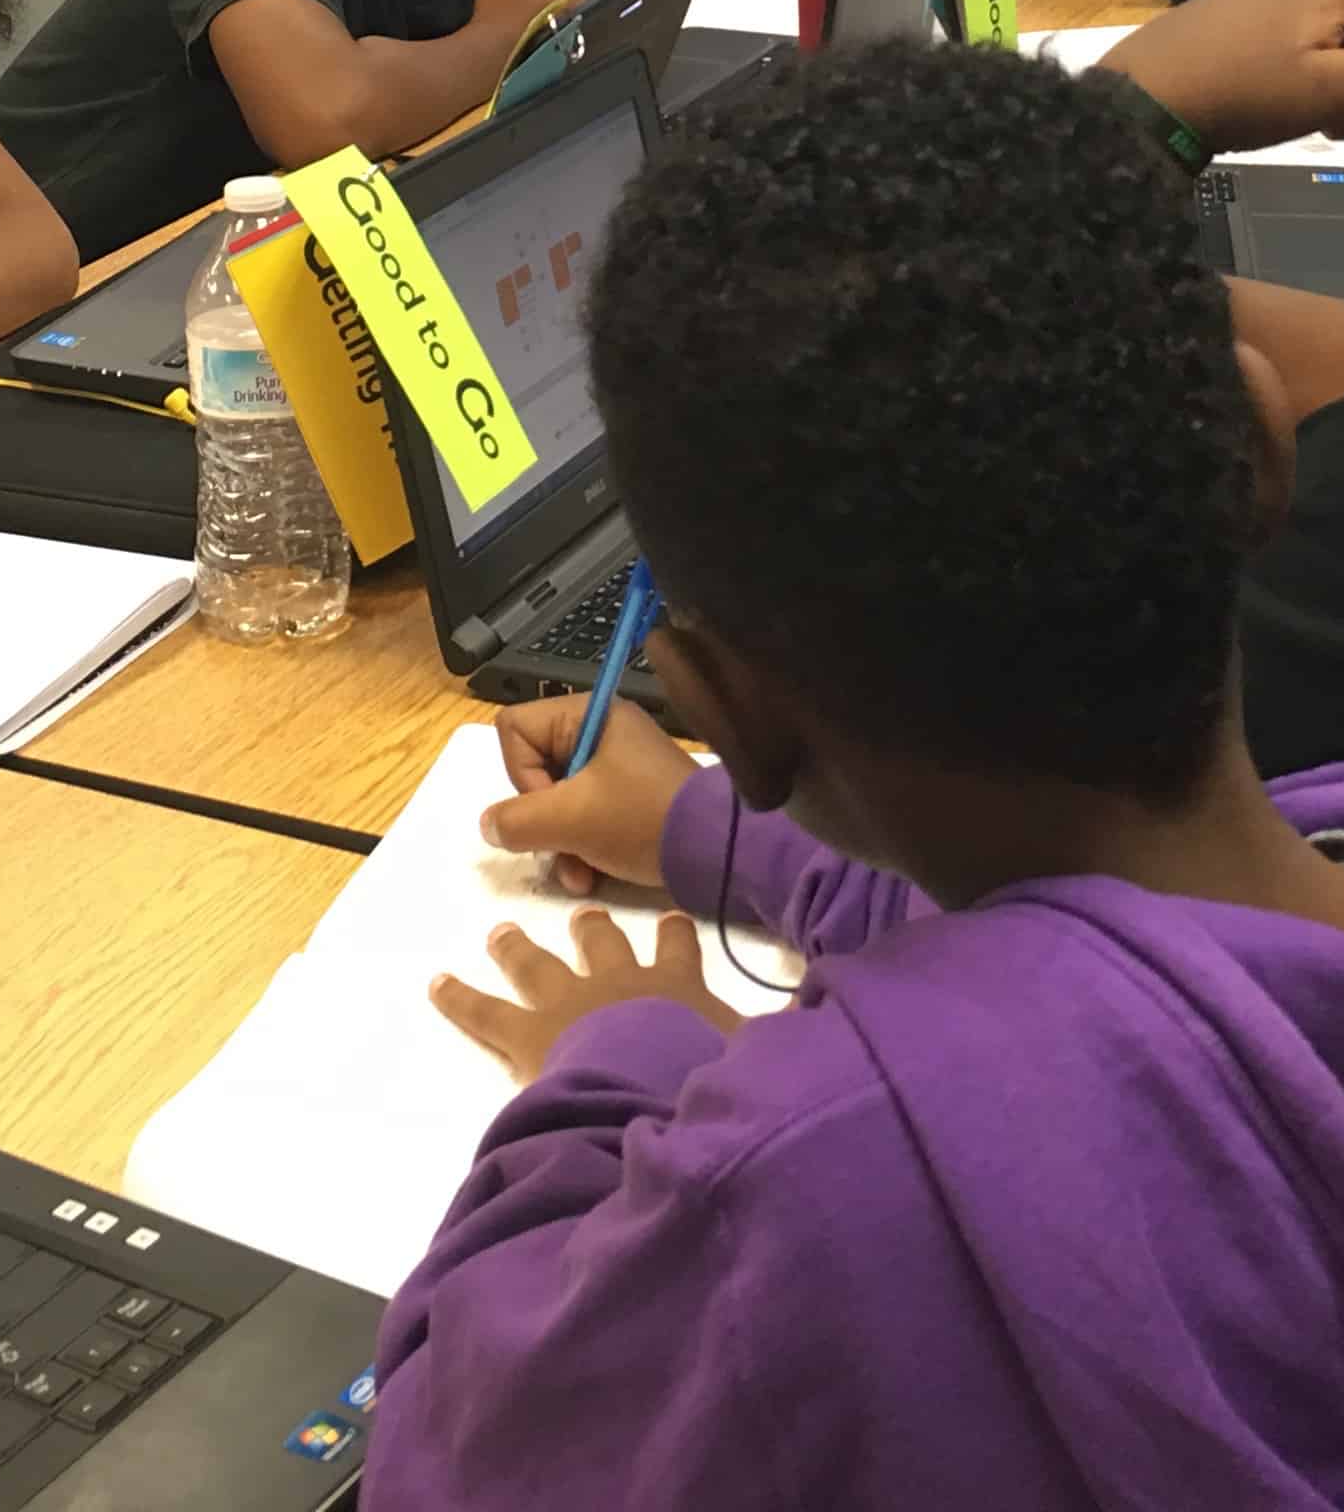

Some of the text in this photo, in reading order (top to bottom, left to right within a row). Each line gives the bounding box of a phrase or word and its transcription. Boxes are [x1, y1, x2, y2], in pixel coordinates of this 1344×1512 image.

[338, 177, 499, 460] Good to Go
[233, 390, 287, 404] Drinking
